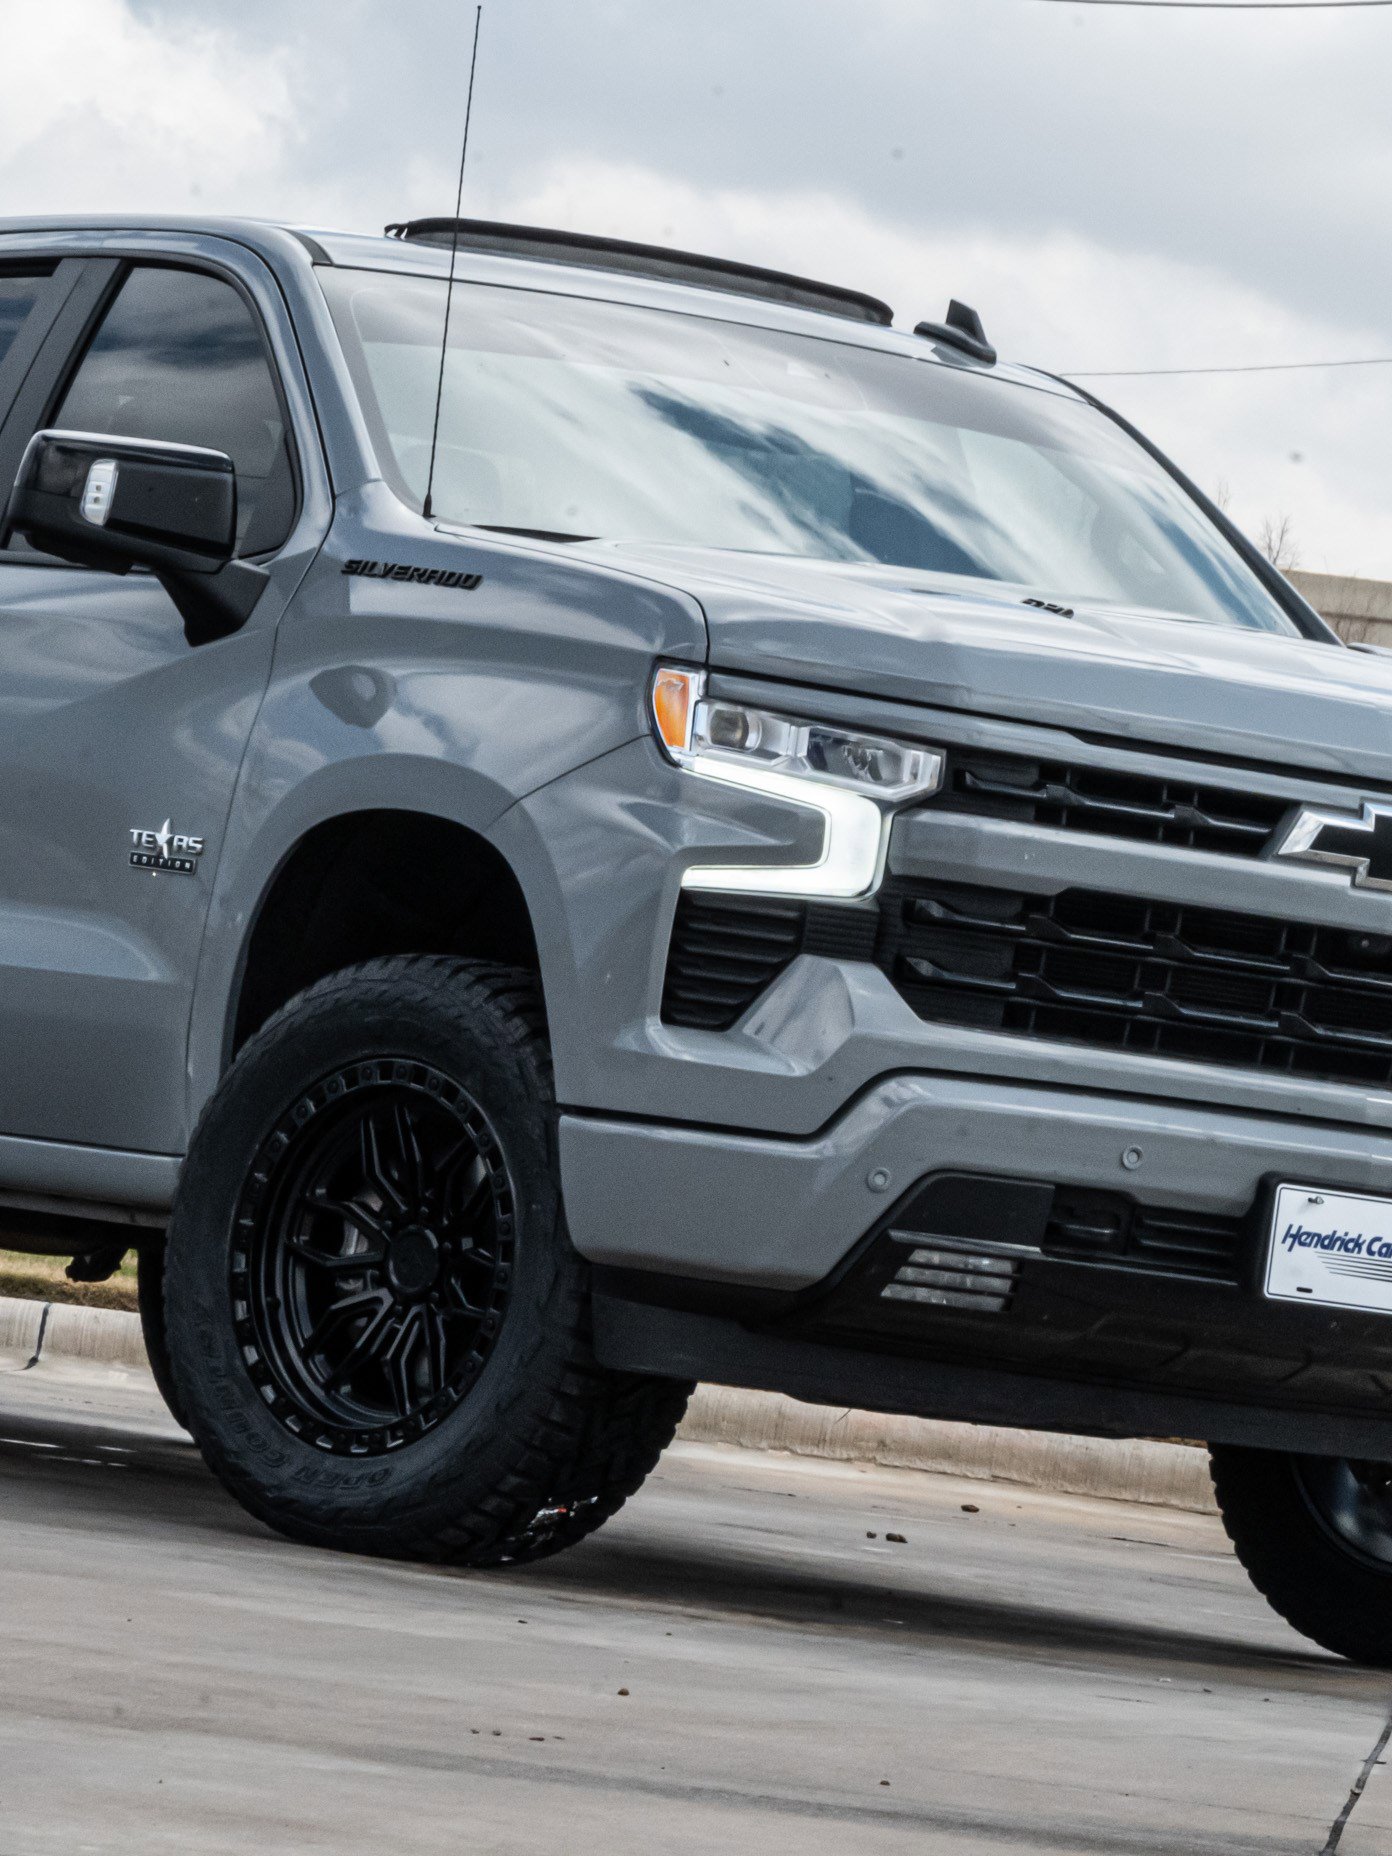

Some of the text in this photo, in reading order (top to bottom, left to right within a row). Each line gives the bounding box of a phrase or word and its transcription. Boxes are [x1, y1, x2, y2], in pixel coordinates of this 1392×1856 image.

[341, 558, 484, 591] SILVERADO
[129, 818, 205, 859] TEXAS
[132, 855, 192, 869] EDITION
